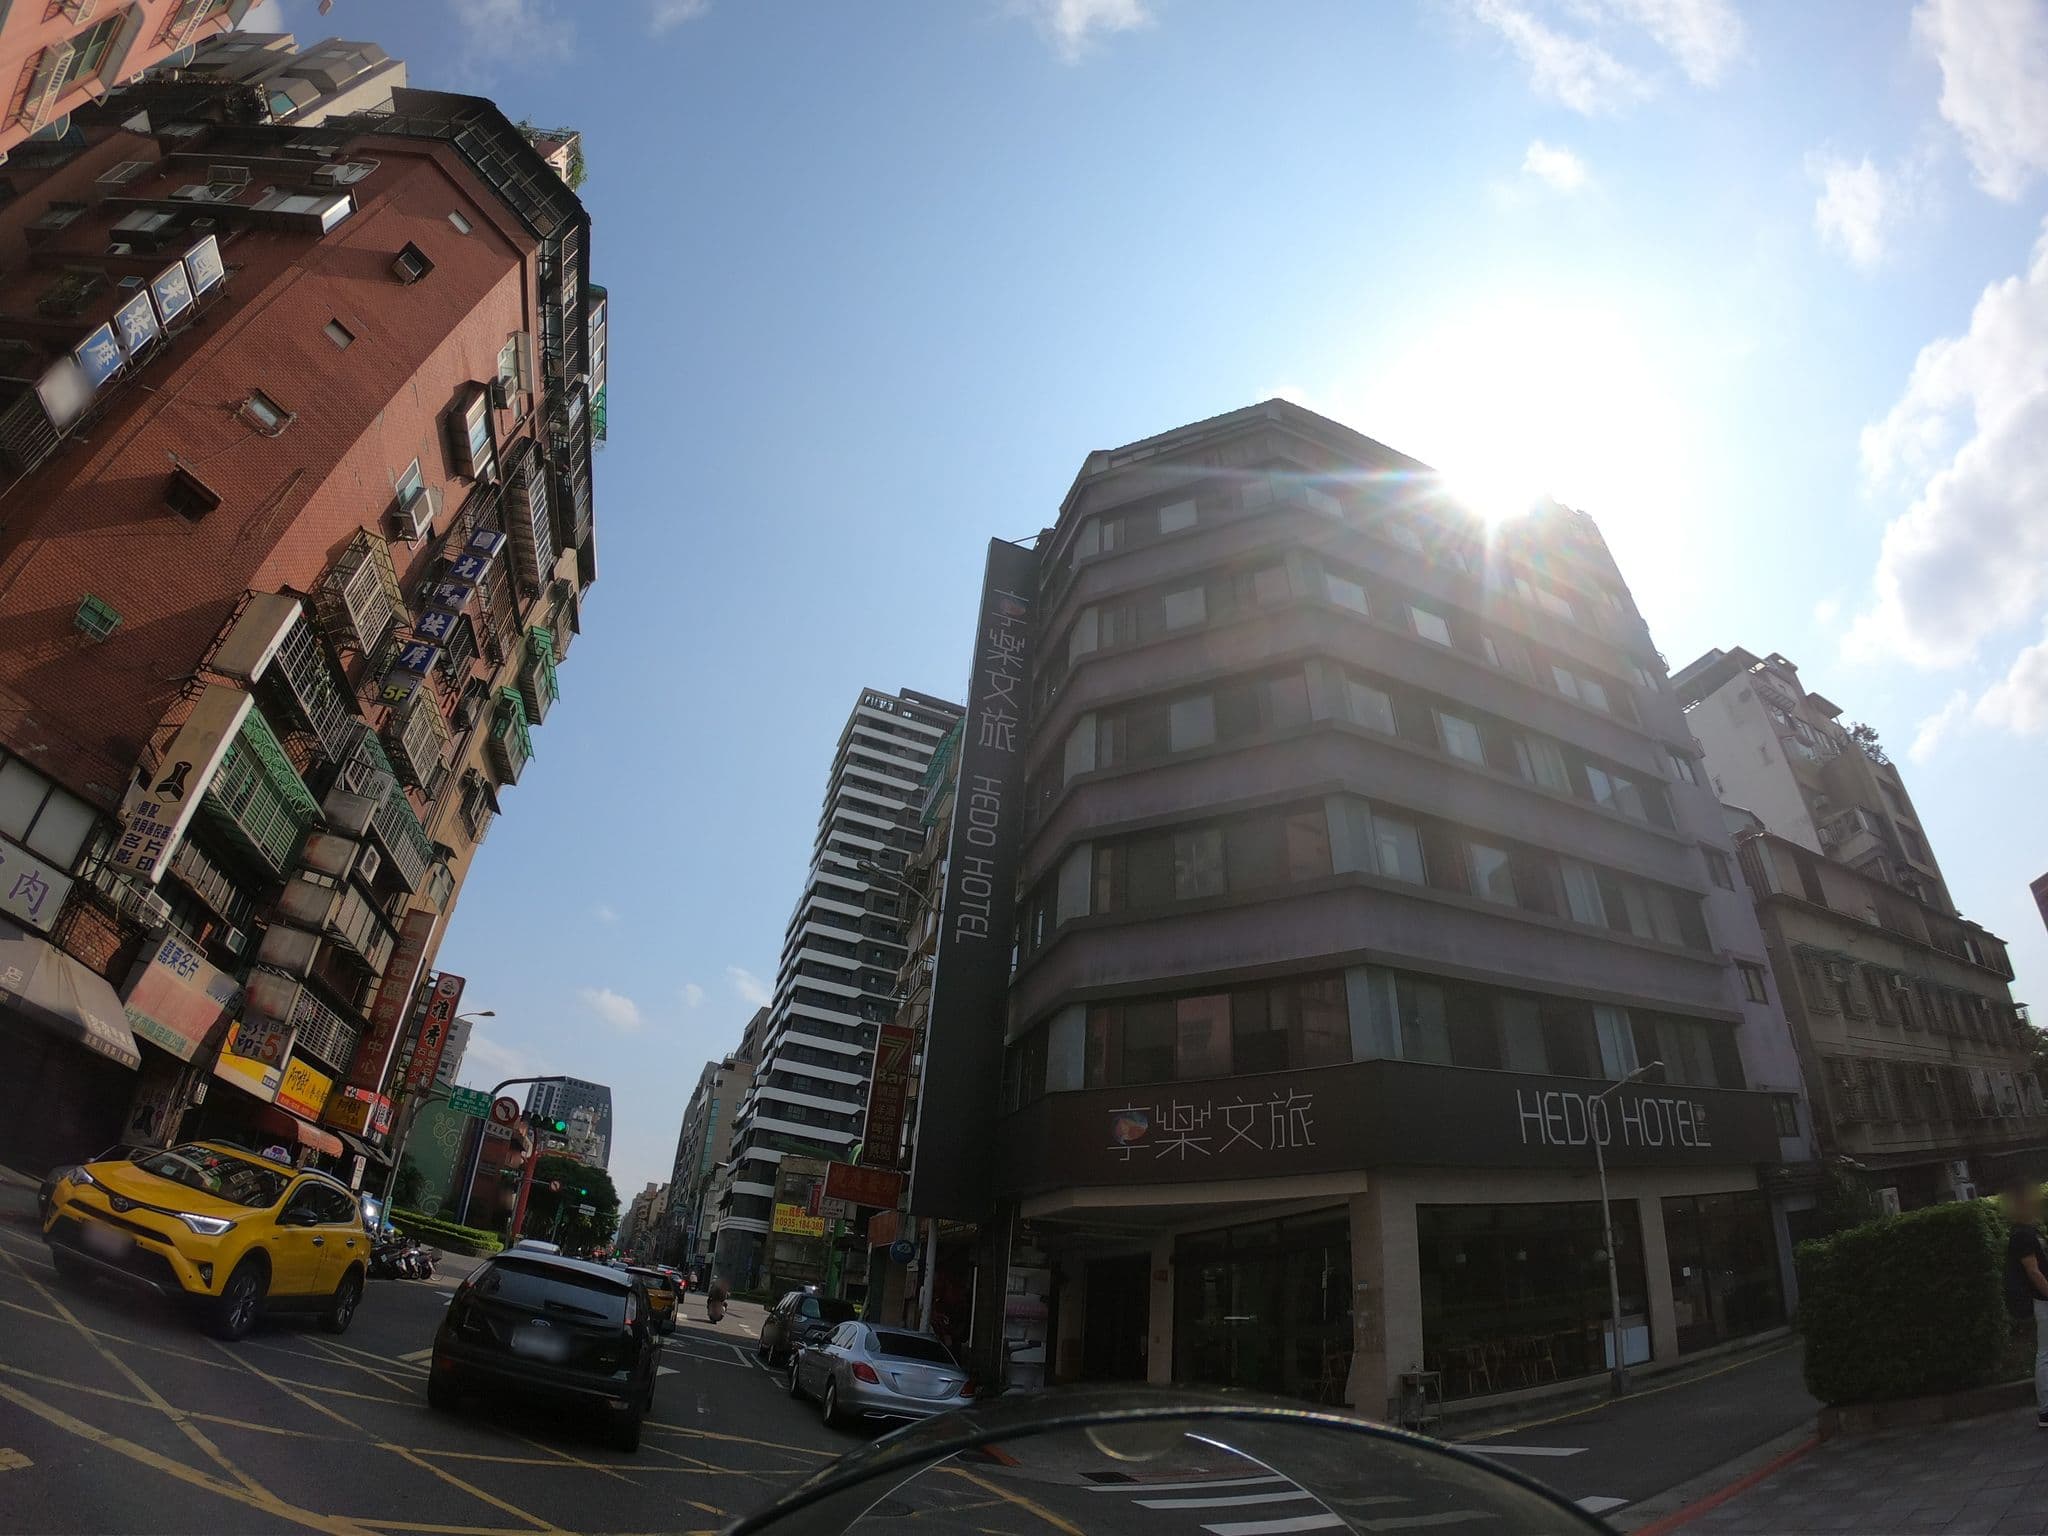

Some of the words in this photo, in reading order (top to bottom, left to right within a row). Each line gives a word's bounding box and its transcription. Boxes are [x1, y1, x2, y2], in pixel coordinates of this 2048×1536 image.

[965, 774, 1003, 849] HEDO
[954, 856, 995, 945] HOTEL
[880, 1035, 911, 1071] 7
[1107, 1088, 1316, 1161] 享樂文旅
[1517, 1089, 1610, 1148] HEDO
[1619, 1096, 1712, 1149] HOTEL
